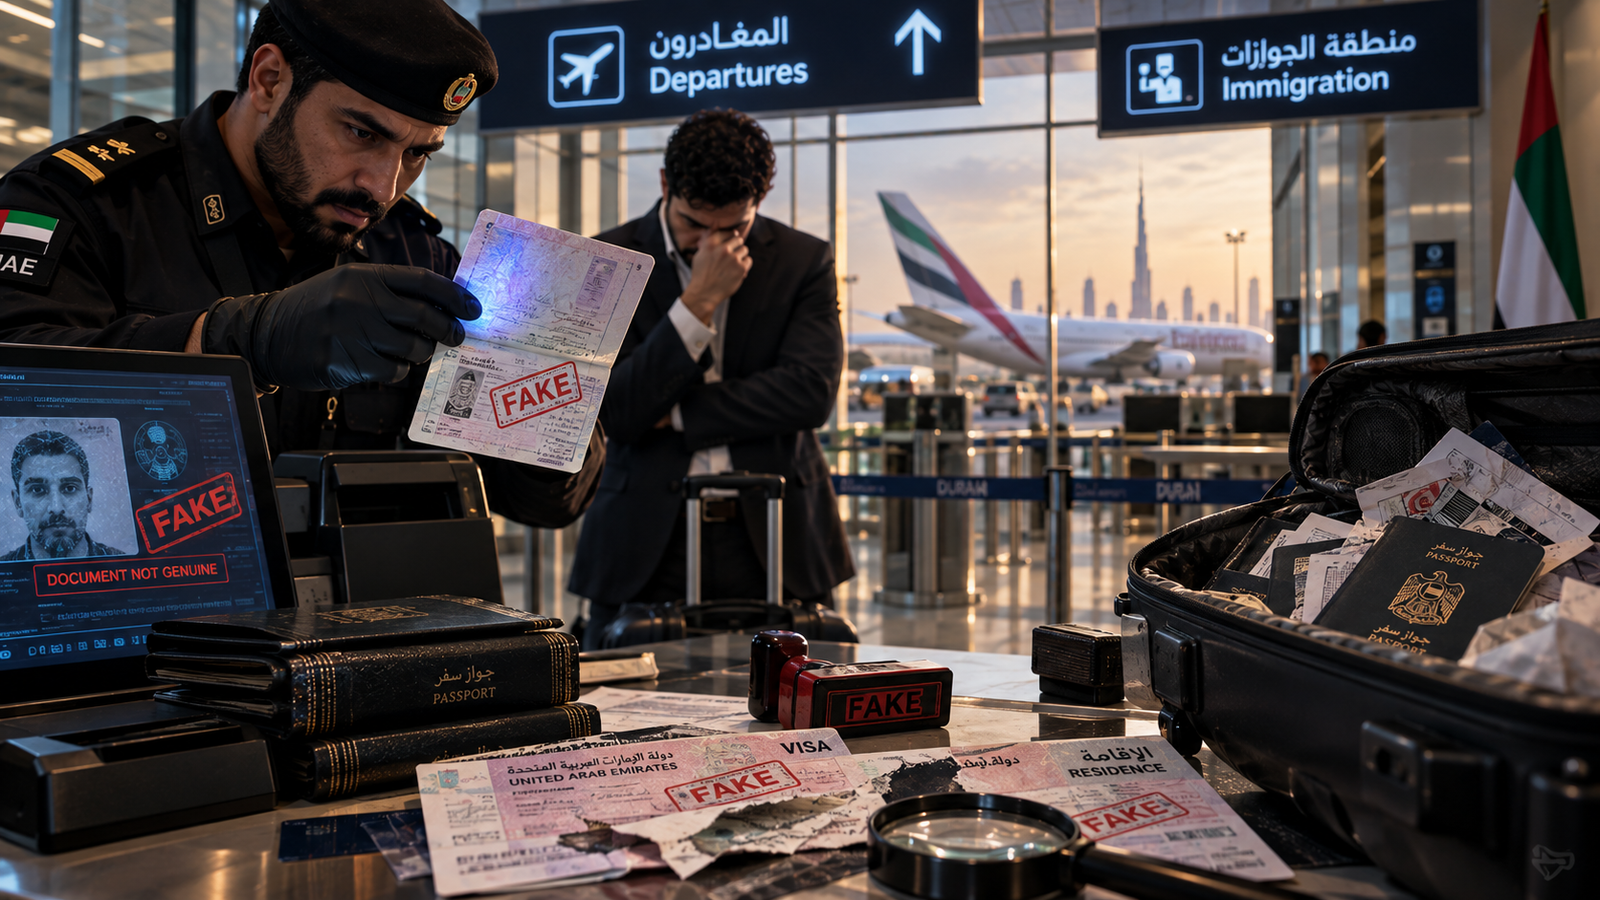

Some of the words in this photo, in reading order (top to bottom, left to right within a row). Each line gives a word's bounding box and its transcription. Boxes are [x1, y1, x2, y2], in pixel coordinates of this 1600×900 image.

[649, 15, 789, 60] المغادرون
[1323, 28, 1417, 57] منطقة
[649, 61, 809, 99] Departures
[1222, 66, 1390, 103] Immigration
[501, 371, 573, 417] FAKE
[150, 484, 232, 539] FAKE
[1430, 541, 1456, 552] سفر
[1455, 546, 1484, 561] جواز
[1425, 550, 1480, 569] PASSPORT
[46, 568, 128, 587] DOCUMENT
[131, 566, 159, 580] NOT
[162, 562, 218, 578] GENUINE
[1372, 624, 1401, 636] سفر
[1400, 630, 1431, 647] جواز
[434, 667, 462, 687] سفر
[464, 665, 495, 684] جواز
[432, 686, 497, 705] PASSPORT
[848, 690, 922, 720] FAKE
[647, 750, 674, 761] دولة
[779, 739, 833, 755] VISA
[1080, 746, 1154, 762] الإقامة
[507, 761, 557, 774] المتحدة
[509, 773, 565, 787] UNITED
[568, 769, 607, 781] ARAB
[610, 761, 679, 776] EMIRATES
[1068, 763, 1168, 778] RESIDENCE
[689, 769, 780, 804] FAKE
[1080, 800, 1169, 833] FAKE
